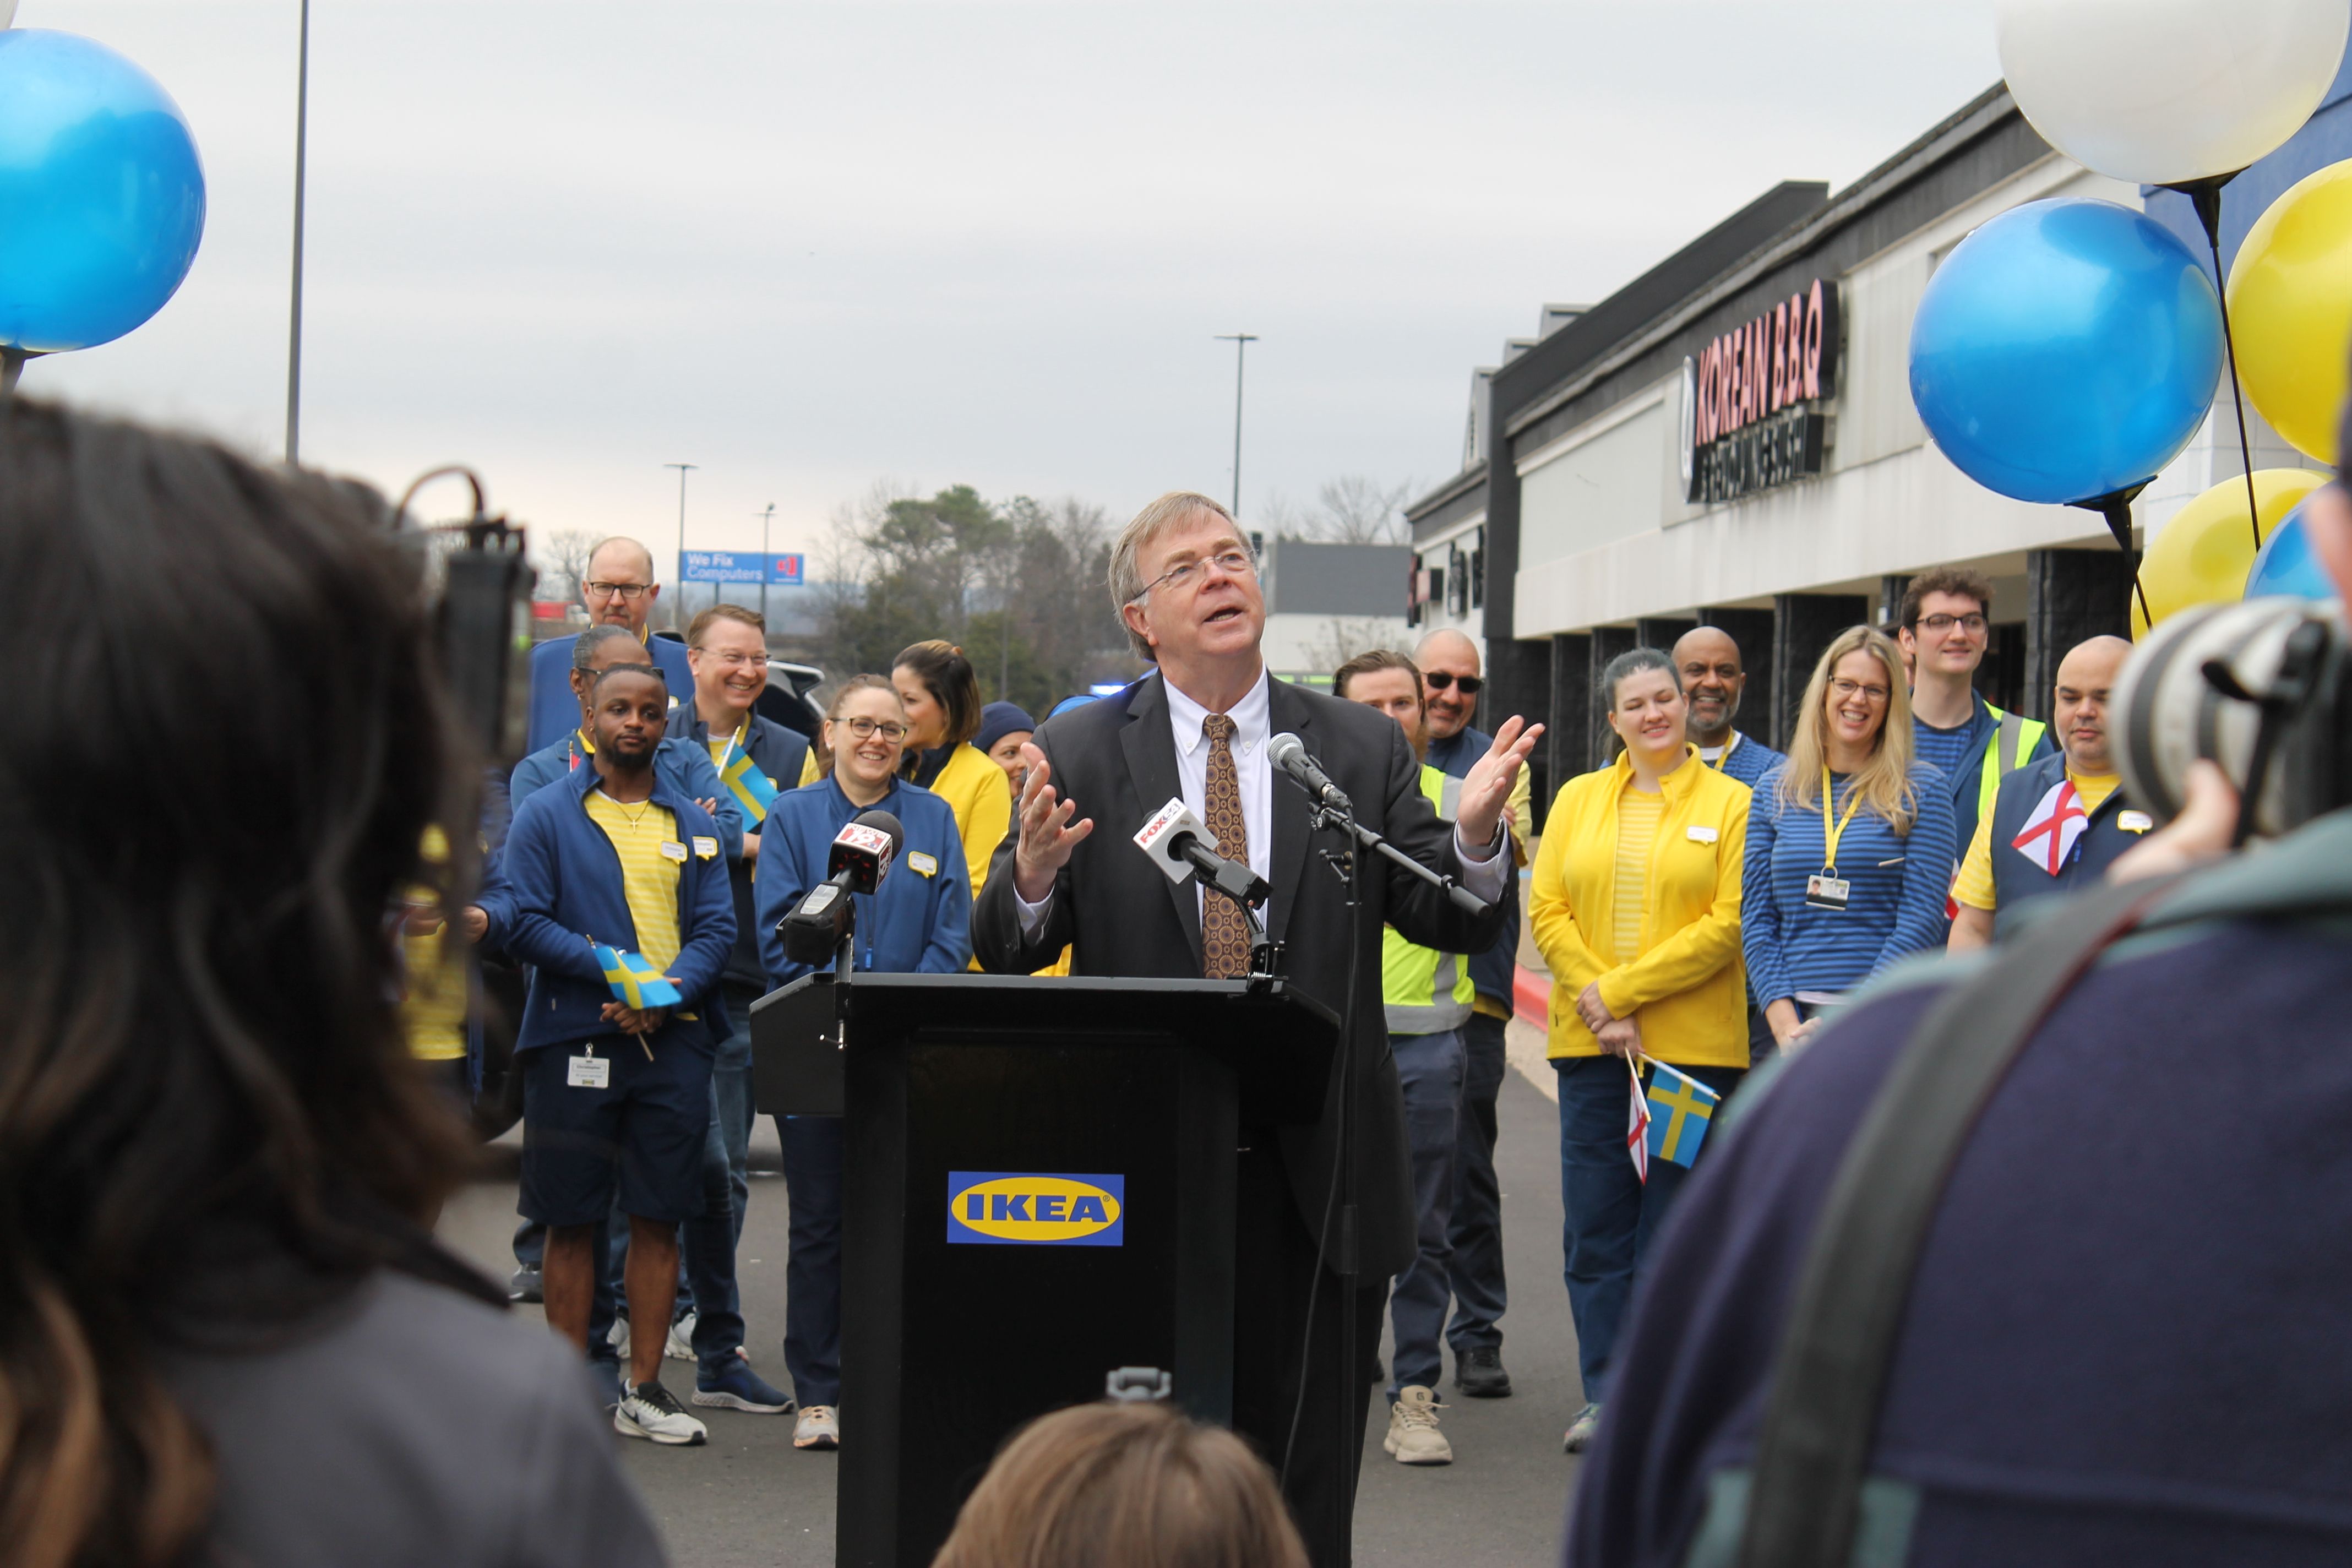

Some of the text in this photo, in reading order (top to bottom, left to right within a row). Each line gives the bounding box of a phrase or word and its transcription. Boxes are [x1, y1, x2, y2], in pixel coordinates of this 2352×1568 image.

[1696, 311, 1771, 447] KOREAN
[687, 553, 734, 567] We Fix
[687, 565, 764, 581] Computers
[846, 830, 875, 845] 19
